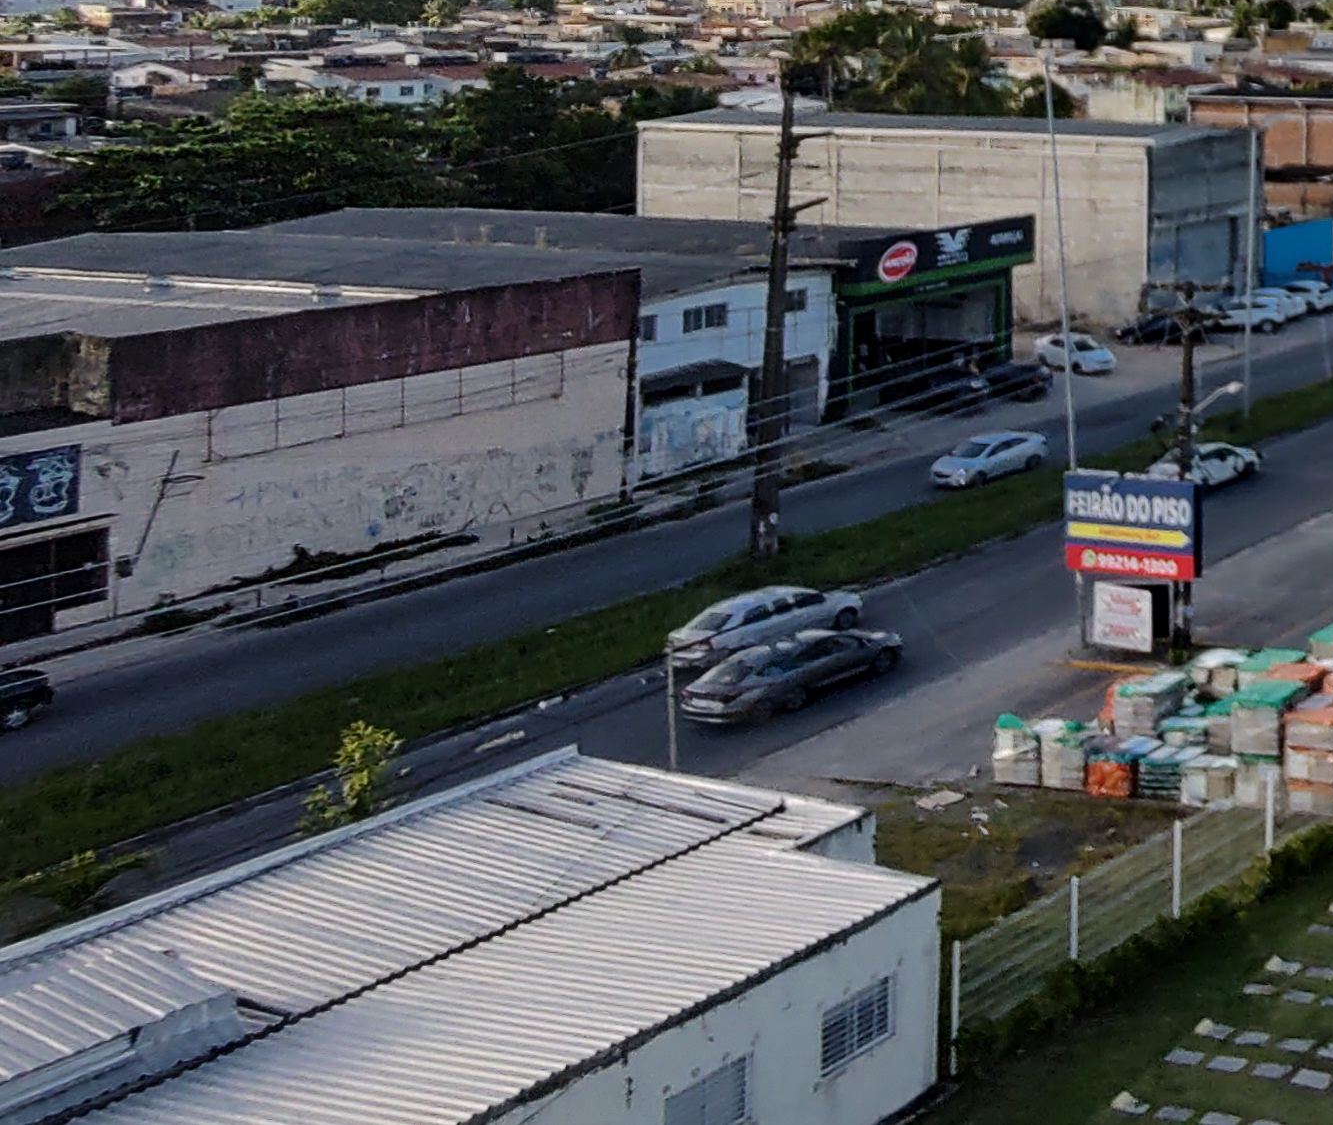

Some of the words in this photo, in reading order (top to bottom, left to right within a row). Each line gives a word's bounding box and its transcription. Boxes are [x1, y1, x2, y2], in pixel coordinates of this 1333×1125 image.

[1067, 484, 1125, 521] FEIRÃO
[1125, 493, 1150, 523] DO
[1151, 495, 1192, 528] PISO
